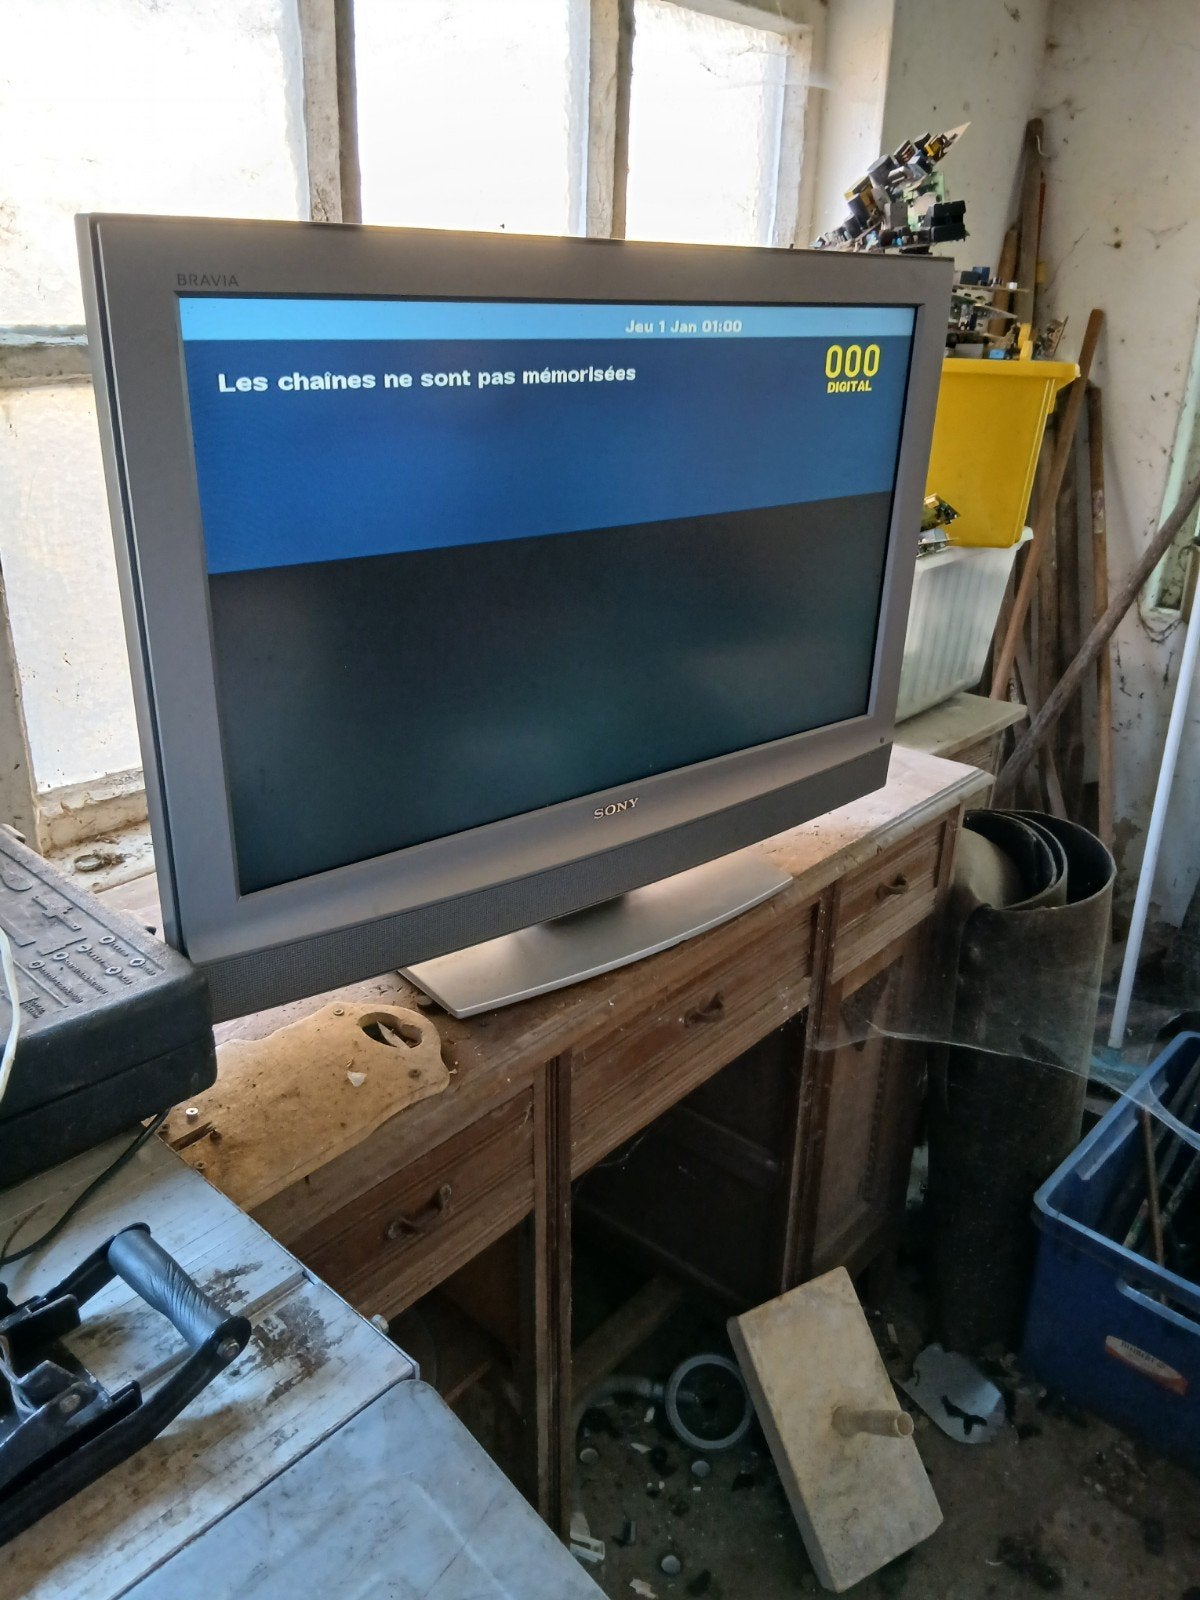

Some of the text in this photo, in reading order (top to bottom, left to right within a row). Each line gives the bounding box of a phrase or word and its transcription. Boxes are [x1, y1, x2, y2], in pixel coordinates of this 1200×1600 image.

[176, 273, 240, 287] BRAVIA
[625, 319, 743, 334] Jeu 1 Jan 01:00
[825, 344, 881, 379] 000
[218, 366, 637, 393] Les chaînes ne sont pas mémorisées
[826, 379, 873, 394] DIGITAL
[593, 797, 639, 819] SONY
